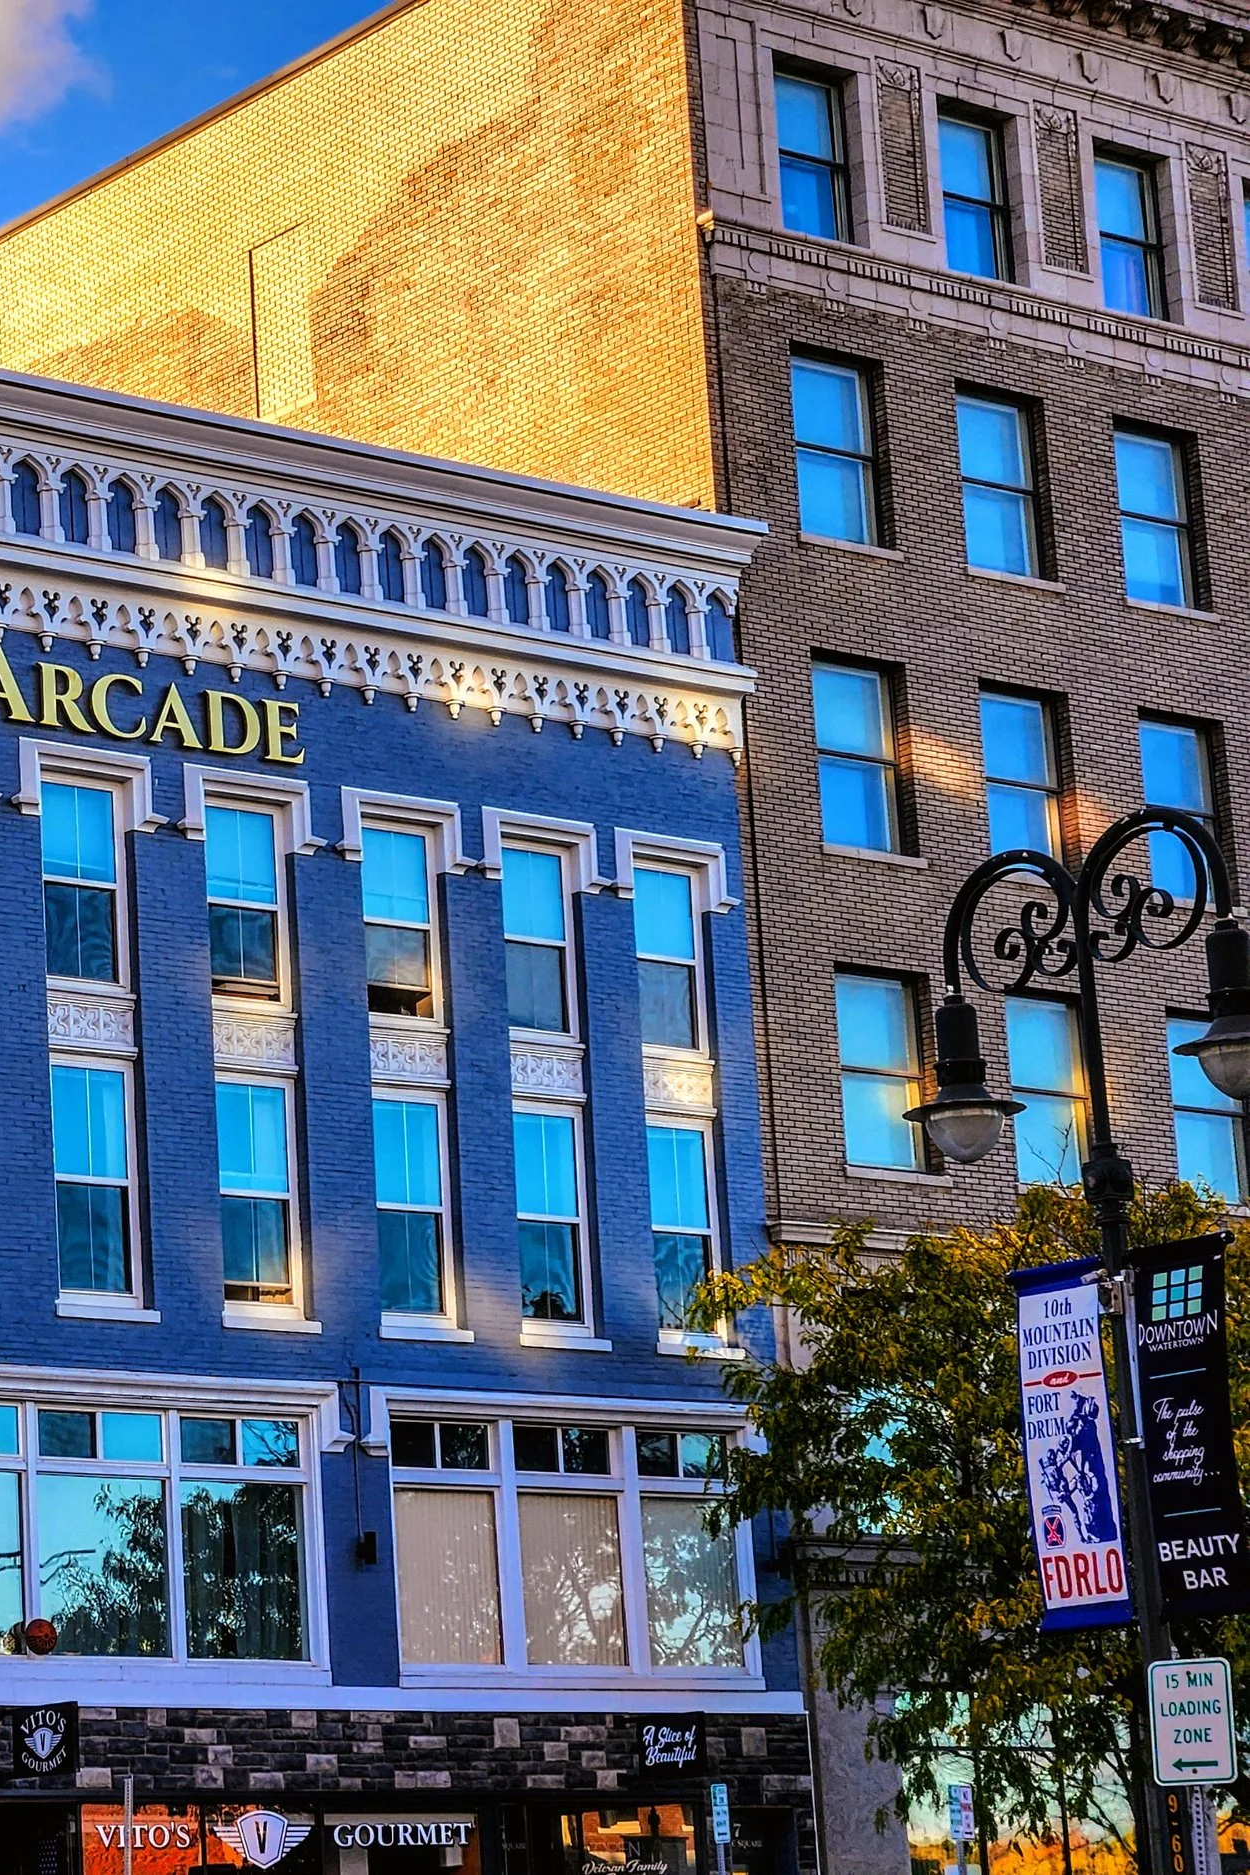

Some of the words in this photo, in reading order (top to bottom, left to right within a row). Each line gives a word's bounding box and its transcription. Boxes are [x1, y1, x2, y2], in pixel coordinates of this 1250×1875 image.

[1044, 1297, 1072, 1318] 10th
[1023, 1317, 1095, 1347] MOUNTAIN
[1139, 1309, 1218, 1346] DOWNTOWN
[1028, 1341, 1092, 1370] DIVISION
[1148, 1336, 1204, 1352] WATERTOWN
[1049, 1373, 1069, 1385] and
[1027, 1392, 1061, 1415] FORT
[1152, 1397, 1174, 1423] The
[1175, 1399, 1204, 1424] pulse
[1027, 1417, 1066, 1440] DRUM
[1166, 1422, 1179, 1446] of
[1183, 1424, 1199, 1437] the
[1163, 1444, 1205, 1466] shopping
[1158, 1533, 1240, 1562] BEAUTY
[1042, 1548, 1124, 1600] FDRLO
[1182, 1566, 1230, 1590] BAR
[1166, 1674, 1179, 1688] 15
[1187, 1672, 1213, 1687] MIN
[1161, 1699, 1221, 1717] LOADING
[20, 1709, 66, 1734] VITO'S
[643, 1725, 655, 1746] A
[658, 1726, 682, 1748] Slice
[684, 1725, 696, 1748] of
[1173, 1728, 1212, 1744] ZONE
[21, 1745, 67, 1773] GOURMET
[645, 1744, 697, 1769] Beautiful
[333, 1822, 474, 1848] GOURMET
[581, 1860, 625, 1875] Veteran
[626, 1859, 668, 1875] Family
